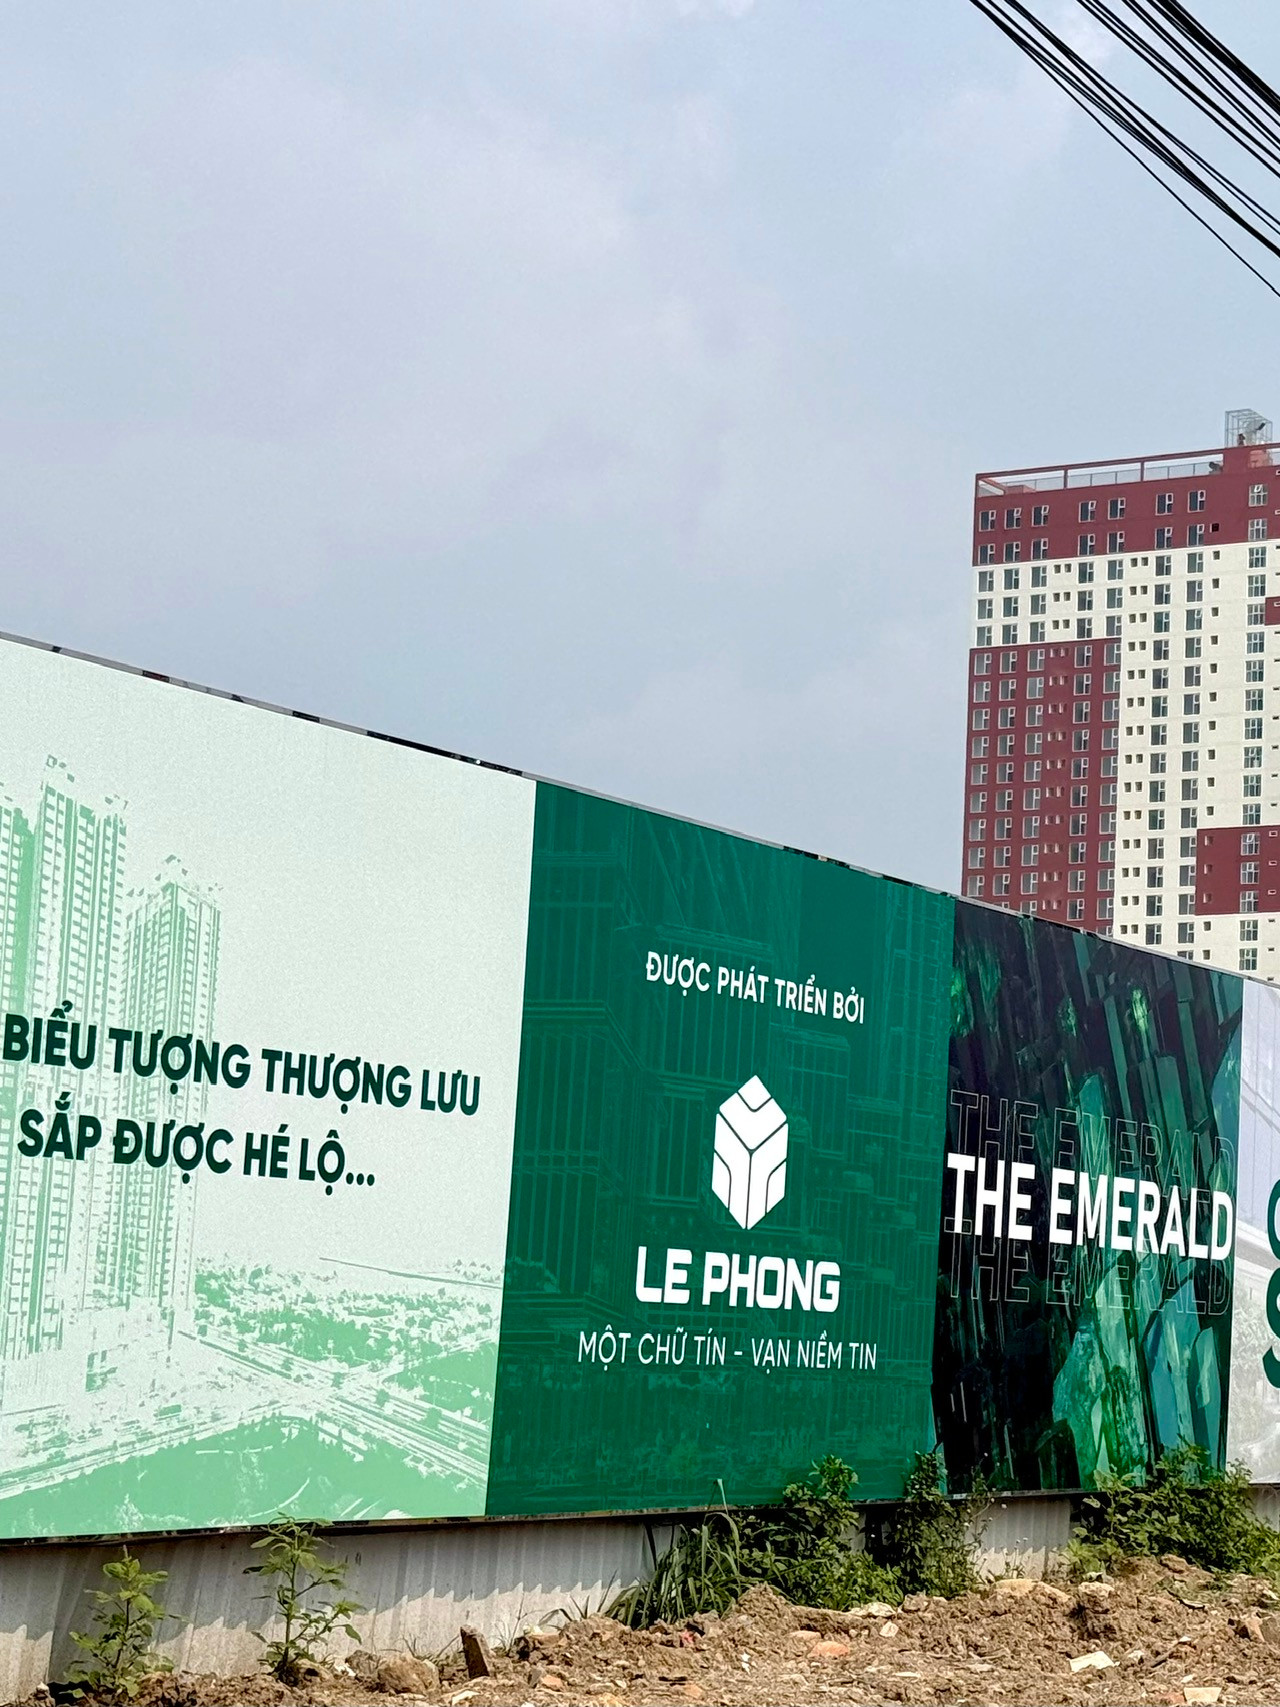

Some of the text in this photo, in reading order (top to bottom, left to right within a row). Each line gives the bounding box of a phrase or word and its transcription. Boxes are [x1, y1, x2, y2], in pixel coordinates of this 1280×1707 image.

[646, 951, 865, 1025] ĐƯỢC PHÁT TRIỂN BỞI
[2, 1000, 482, 1117] BIỂU TƯỢNG THƯỢNG LƯU
[17, 1091, 375, 1197] SẮP ĐƯỢC HÉ LỘ...
[946, 1152, 1234, 1262] THE EMERALD
[635, 1245, 841, 1314] LE PHONG
[577, 1324, 632, 1372] MỘT
[637, 1328, 689, 1366] CHỮ
[693, 1328, 727, 1367] TÍN
[751, 1337, 791, 1375] VẠN
[797, 1330, 843, 1370] NIỀM
[849, 1342, 878, 1371] TIN
